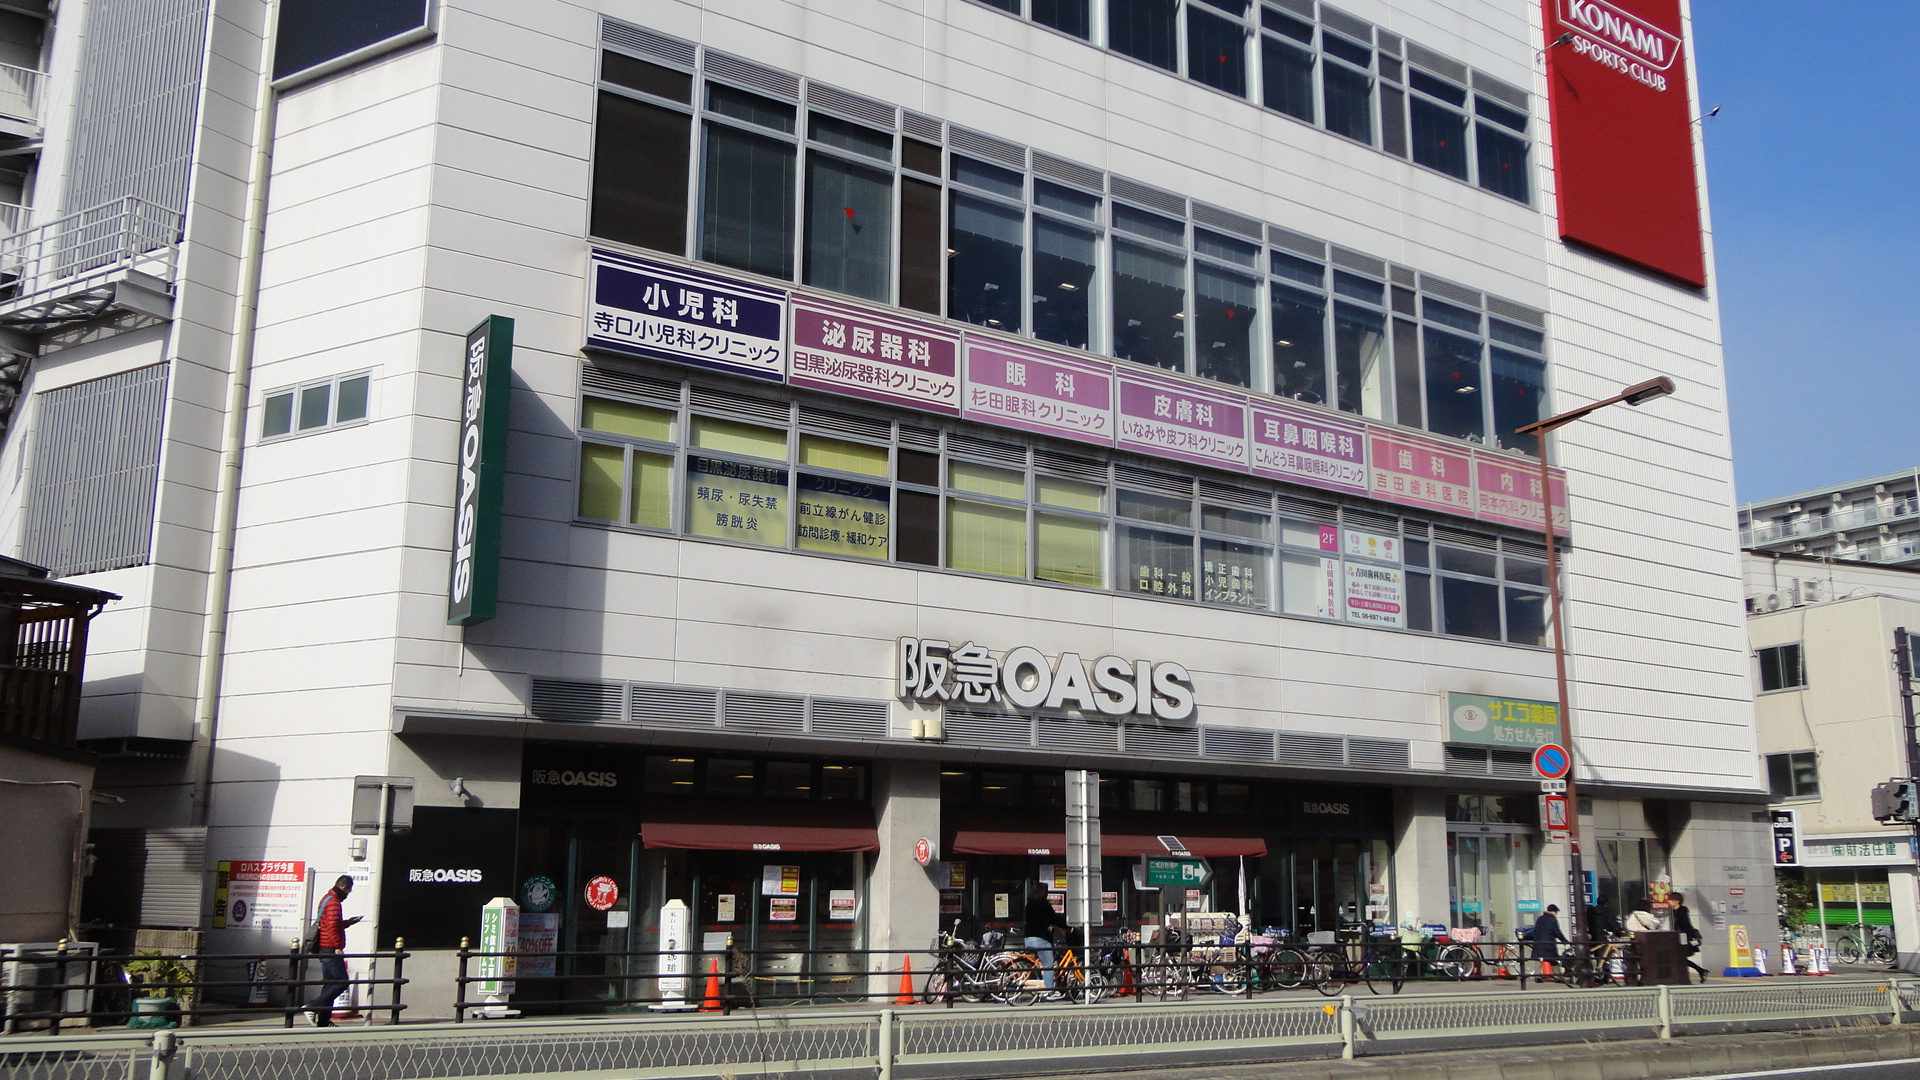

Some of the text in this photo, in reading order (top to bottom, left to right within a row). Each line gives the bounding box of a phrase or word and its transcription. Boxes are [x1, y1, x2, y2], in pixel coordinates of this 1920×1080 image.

[1569, 0, 1664, 62] KONAMI
[1572, 35, 1667, 92] SPORTS CLUB
[642, 281, 739, 327] 小児科
[594, 311, 780, 364] 寺口小児科クリニック
[821, 318, 931, 367] 泌尿器科
[793, 351, 955, 399] 目黒泌尿器科クリニック
[1005, 360, 1075, 398] 眼科
[971, 387, 1106, 430] 杉田眼科クリニック
[1154, 394, 1214, 428] 皮膚科
[1122, 419, 1244, 458] いなみや皮フ科クリニック
[1264, 418, 1355, 458] 耳鼻咽喉科
[453, 334, 486, 605] 阪急OASIS
[697, 457, 779, 484] 目黒泌尿器科
[1255, 446, 1365, 483] こんどう耳鼻咽喉科クリニック
[1398, 449, 1446, 478] 歯科
[697, 486, 778, 511] 頻尿・尿失禁
[814, 476, 874, 498] クリニック
[1375, 472, 1469, 506] 吉田歯科医院
[1500, 472, 1543, 499] 内科
[716, 512, 759, 532] 膀胱炎
[1322, 533, 1335, 545] 2F
[1140, 565, 1192, 584] 歯科一般
[1204, 560, 1253, 579] 矯正歯科
[1205, 574, 1254, 591] 小児歯科
[1355, 567, 1392, 582] 吉田歯科医院
[1140, 579, 1192, 597] 口腔外科
[1204, 588, 1254, 605] インプラント
[1326, 560, 1335, 618] 吉田歯科医院
[1351, 611, 1361, 619] TEL
[895, 635, 1197, 721] 阪急OASIS
[1488, 700, 1558, 726] サエラ薬局
[1493, 725, 1555, 744] 処方せん受付
[532, 769, 618, 788] 阪急OASIS
[1303, 801, 1350, 815] 阪急OASIS
[1780, 838, 1791, 851] P
[240, 862, 295, 873] ロハスプラザ今里
[409, 868, 482, 883] 阪急OASIS
